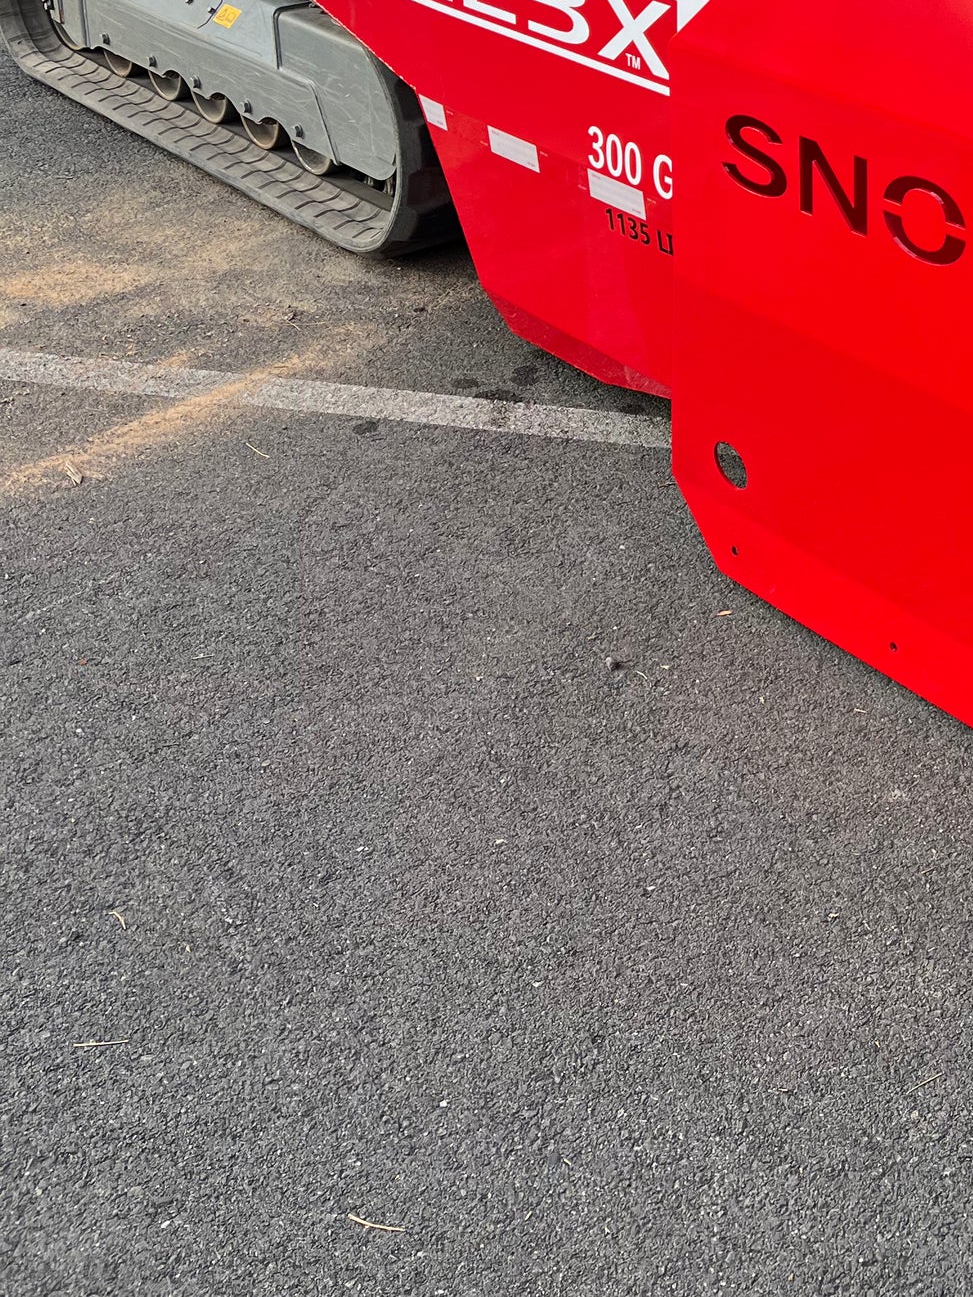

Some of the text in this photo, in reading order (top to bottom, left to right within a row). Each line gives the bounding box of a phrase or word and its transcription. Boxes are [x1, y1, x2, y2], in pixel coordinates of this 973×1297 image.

[587, 126, 673, 199] 300 G
[605, 208, 651, 245] 1135
